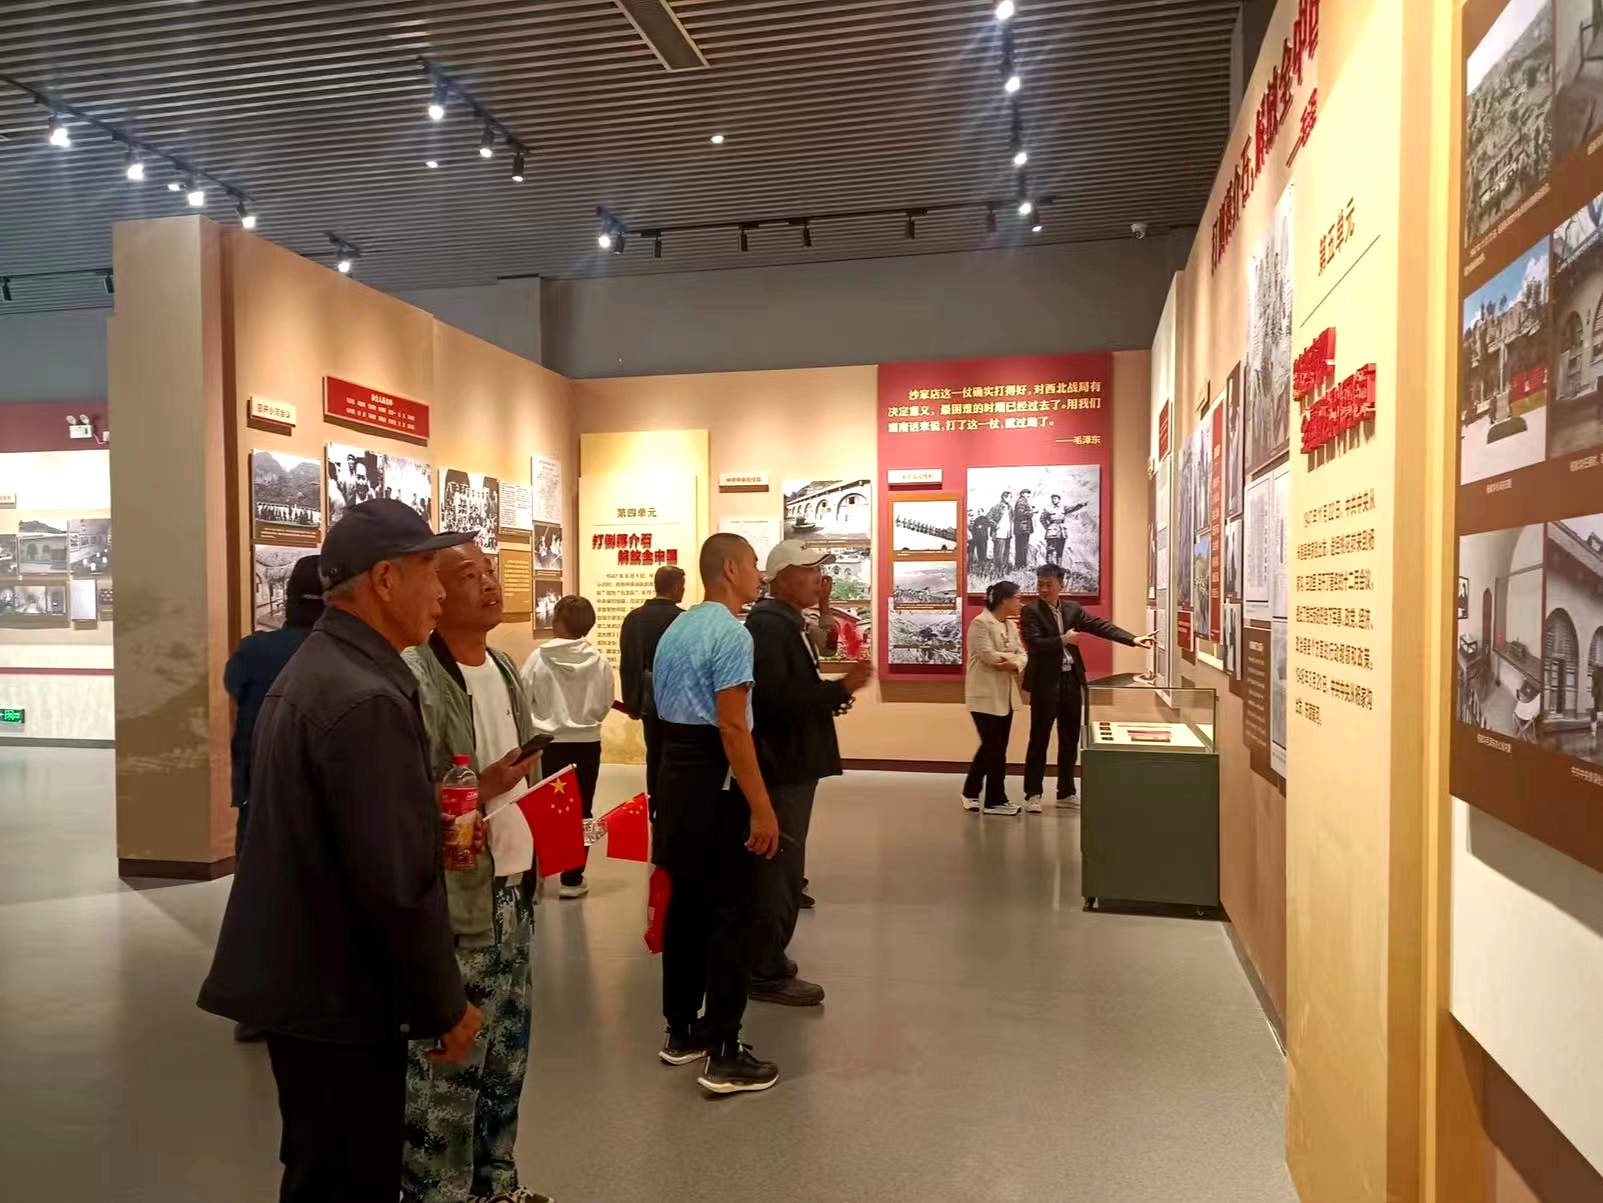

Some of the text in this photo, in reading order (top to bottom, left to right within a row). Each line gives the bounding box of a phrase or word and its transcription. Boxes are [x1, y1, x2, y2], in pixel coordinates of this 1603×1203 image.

[617, 507, 657, 518] 第四单元
[592, 533, 652, 550] 打倒蒋介石
[617, 549, 678, 566] 解放全中国
